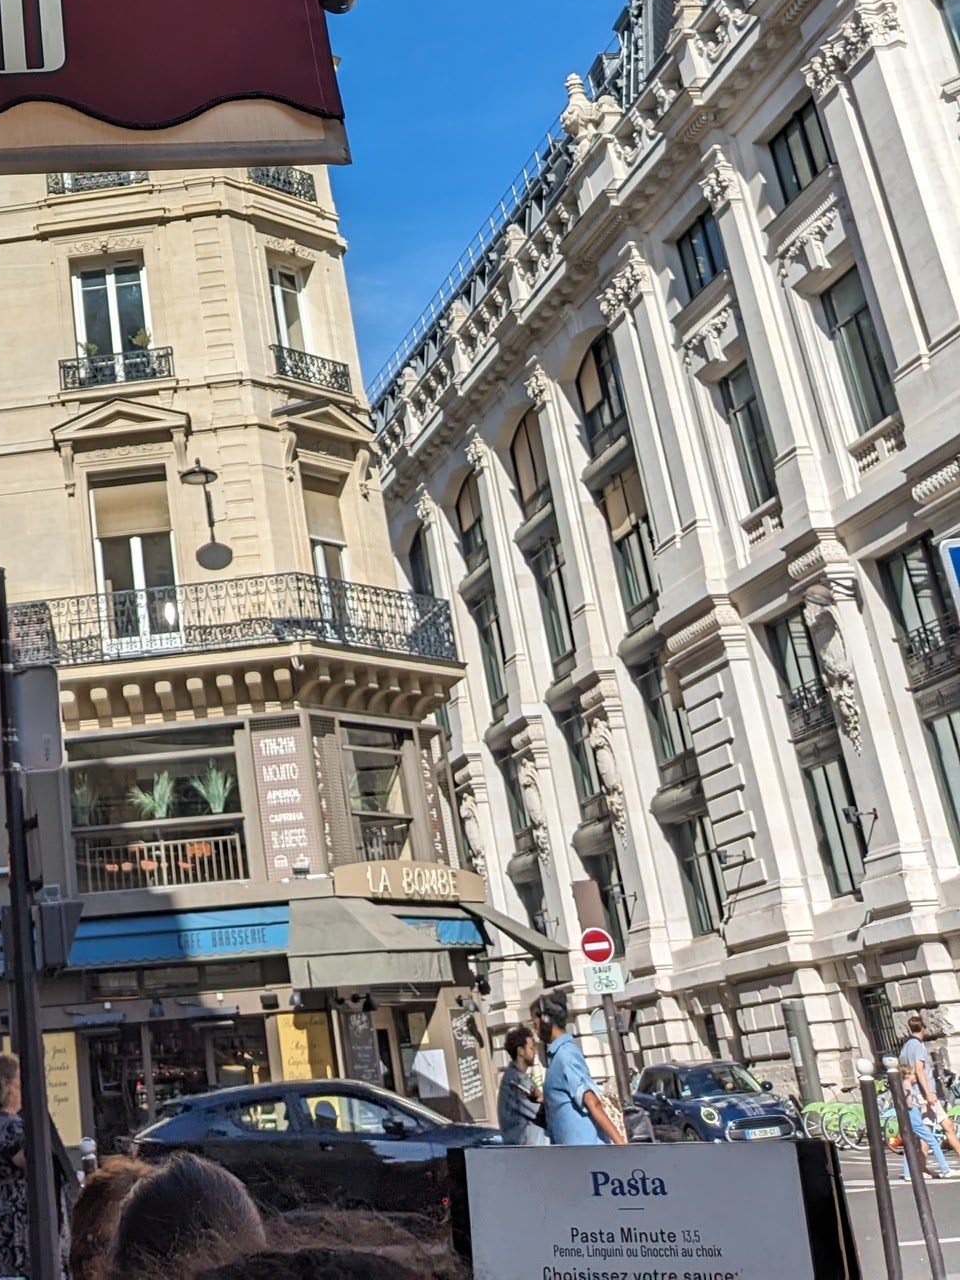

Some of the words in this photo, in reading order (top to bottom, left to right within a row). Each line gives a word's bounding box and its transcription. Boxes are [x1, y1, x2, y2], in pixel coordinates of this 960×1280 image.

[262, 763, 299, 782] MOJITO
[267, 789, 301, 799] APEROL
[367, 866, 392, 894] LA
[403, 867, 460, 897] BOMBE
[211, 927, 267, 948] BRASSERIE
[592, 965, 612, 974] SAUF
[590, 1169, 668, 1198] Pasta
[570, 1227, 615, 1244] Pasta
[619, 1227, 677, 1244] Minute
[681, 1230, 700, 1245] 13,5
[553, 1245, 585, 1259] Penne,
[587, 1245, 623, 1261] Linguini
[626, 1248, 638, 1258] ou
[640, 1245, 678, 1258] Gnocchi
[682, 1247, 693, 1258] au
[696, 1244, 723, 1258] choix
[632, 1269, 678, 1280] votre
